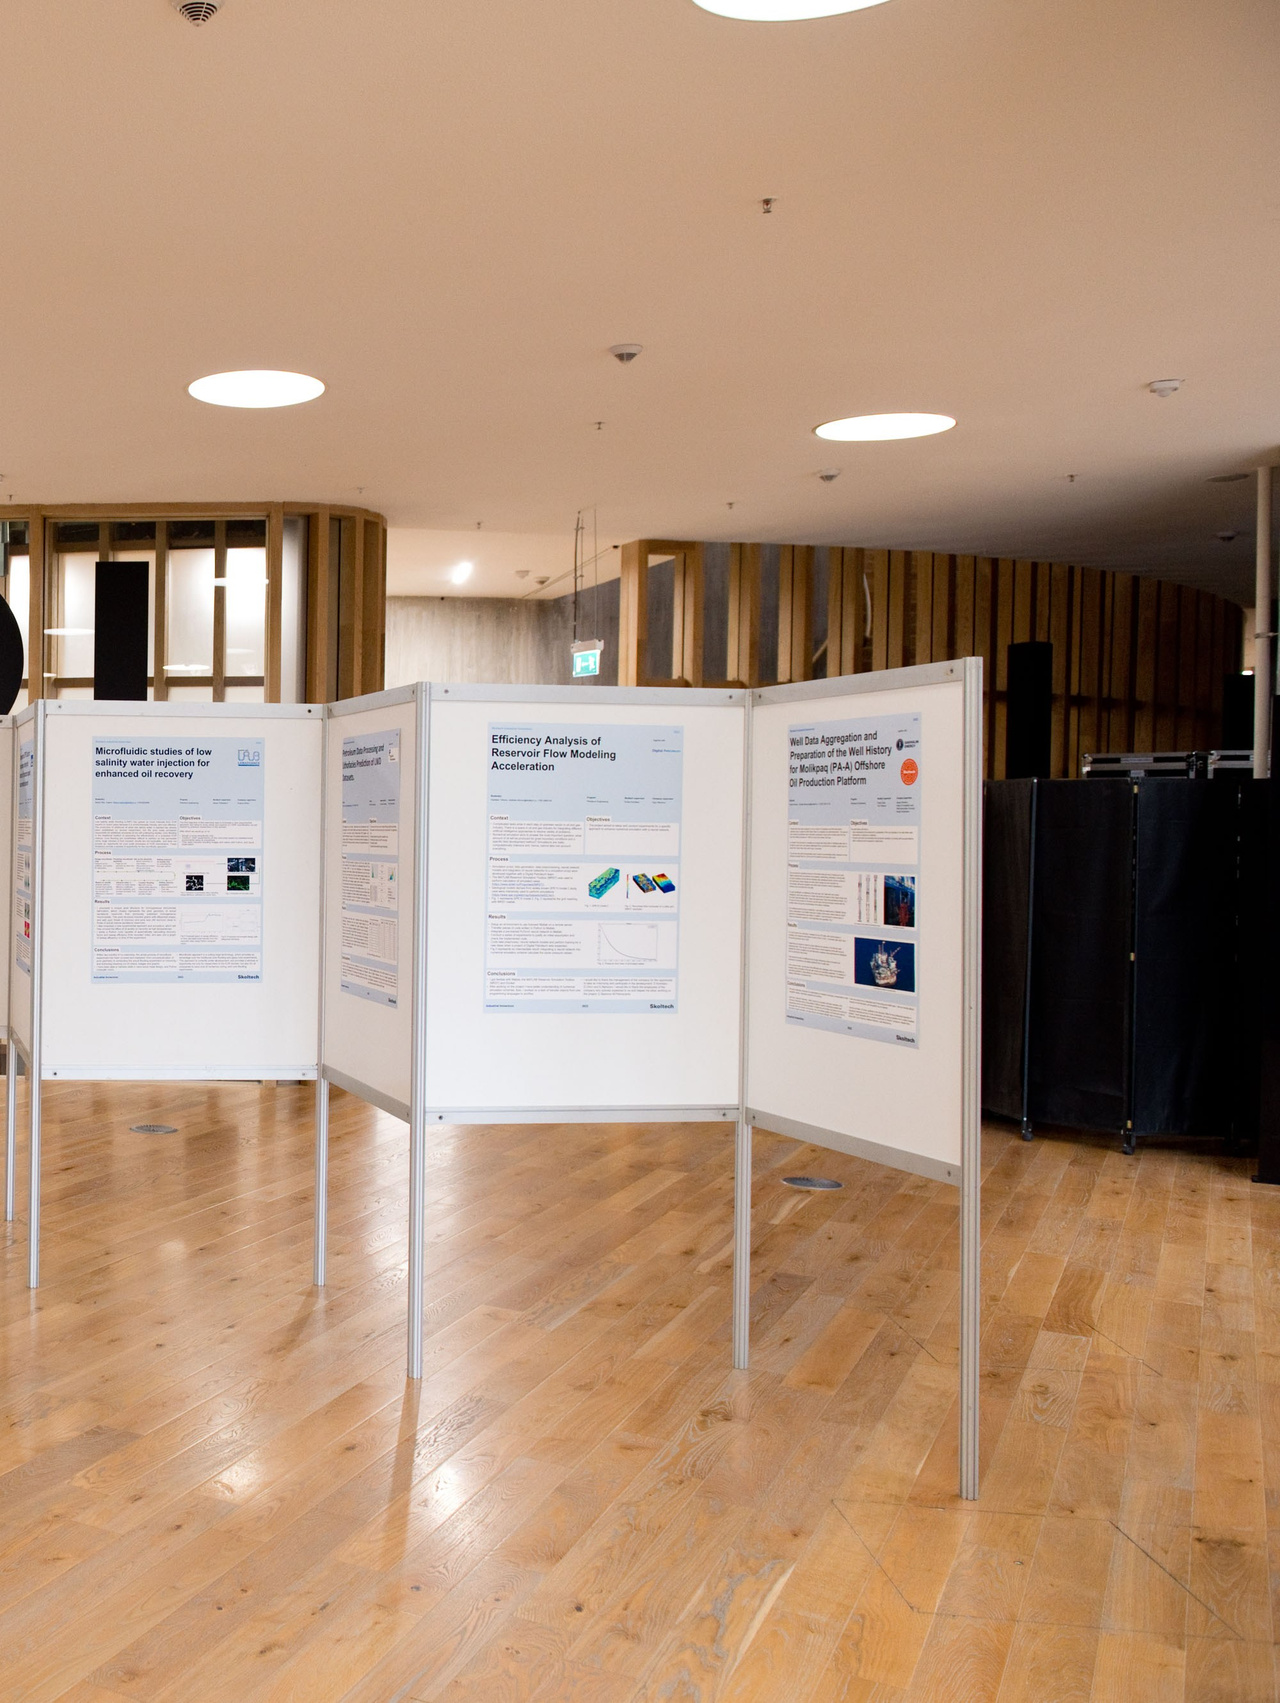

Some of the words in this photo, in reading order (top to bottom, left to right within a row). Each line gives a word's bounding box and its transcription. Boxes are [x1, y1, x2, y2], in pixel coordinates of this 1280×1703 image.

[492, 735, 542, 747] Efficiency
[544, 736, 588, 748] Analysis
[591, 737, 601, 746] of
[790, 737, 803, 747] Well
[805, 736, 819, 746] Data
[820, 732, 862, 746] Aggregation
[864, 731, 878, 740] and
[96, 747, 148, 755] Microfluidic
[150, 748, 182, 756] studies
[185, 748, 195, 756] of
[491, 748, 540, 758] Reservoir
[543, 749, 567, 758] Flow
[570, 749, 616, 761] Modeling
[790, 750, 825, 761] Preparation
[827, 748, 835, 757] of
[836, 748, 847, 757] the
[849, 746, 864, 756] Well
[866, 745, 892, 756] History
[95, 758, 127, 768] salinity
[157, 759, 195, 768] injection
[491, 762, 555, 771] Acceleration
[790, 765, 798, 774] for
[800, 764, 828, 774] Molikpaq
[830, 762, 852, 774] (PA-A)
[854, 760, 885, 771] Offshore
[154, 771, 193, 779] recovery
[799, 777, 835, 787] Production
[837, 776, 866, 785] Platform
[896, 1035, 915, 1044] Skoltech
